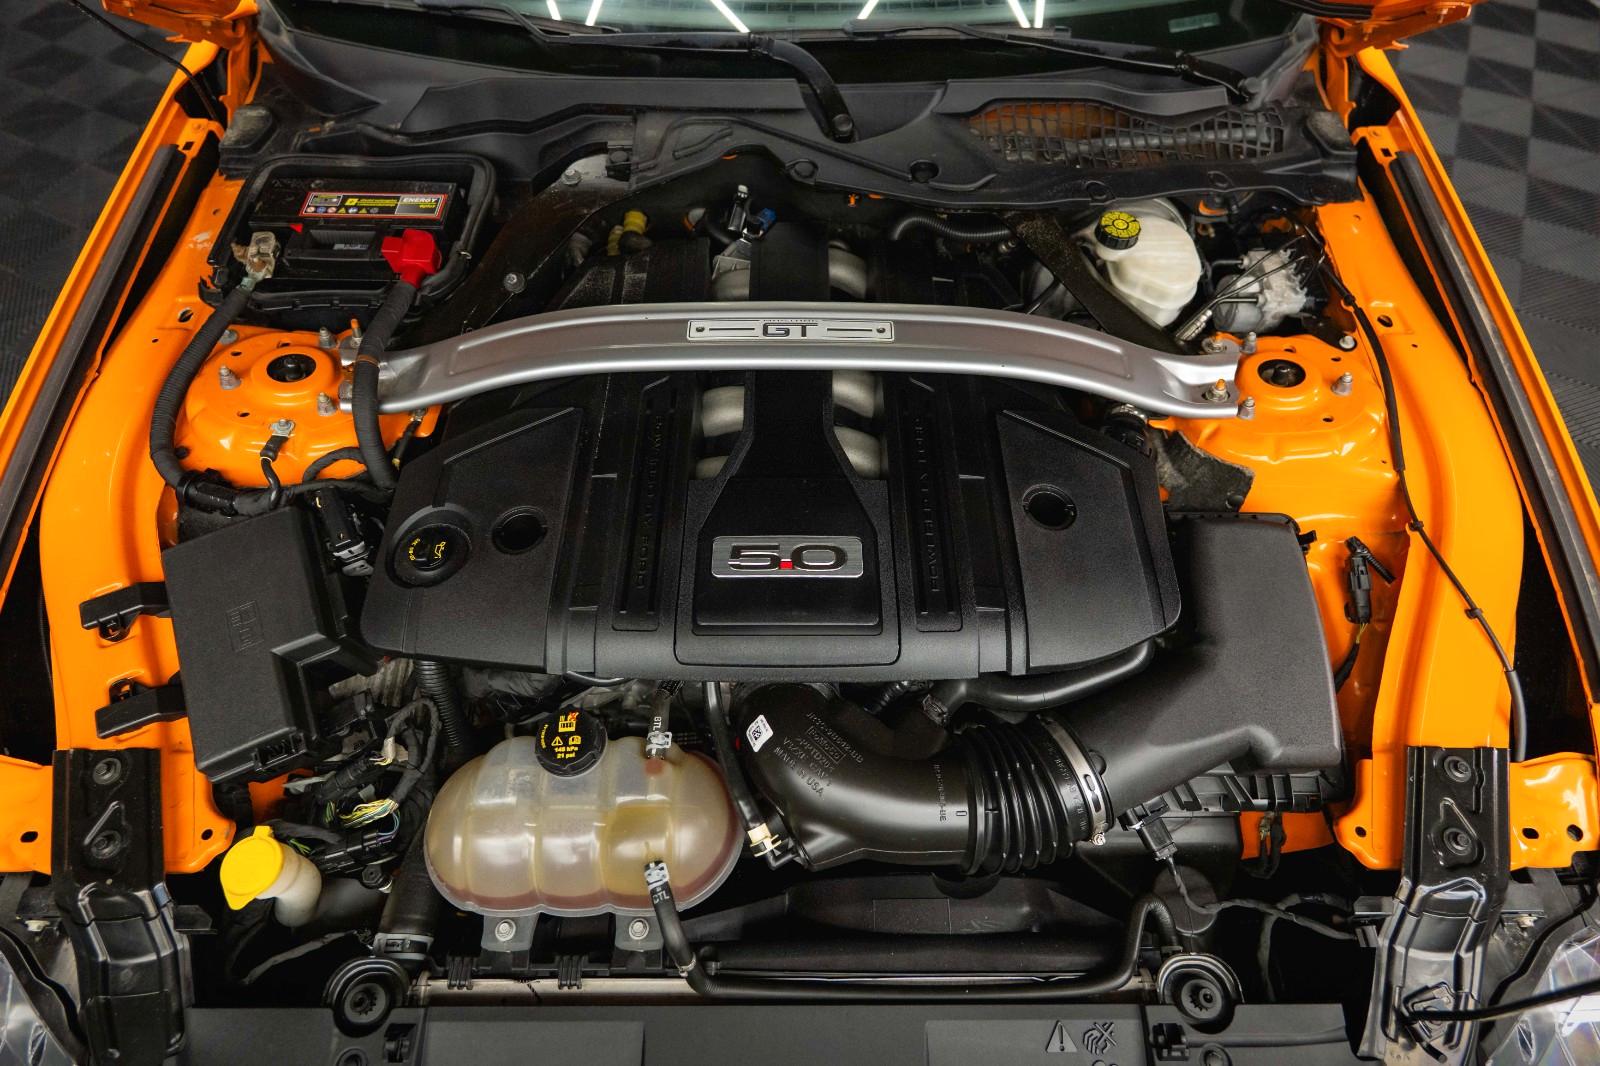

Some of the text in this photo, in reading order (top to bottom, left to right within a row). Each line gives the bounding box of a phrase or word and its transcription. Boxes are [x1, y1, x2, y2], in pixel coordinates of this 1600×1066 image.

[763, 322, 818, 337] GT
[728, 543, 848, 571] 5.0
[807, 777, 824, 797] USA
